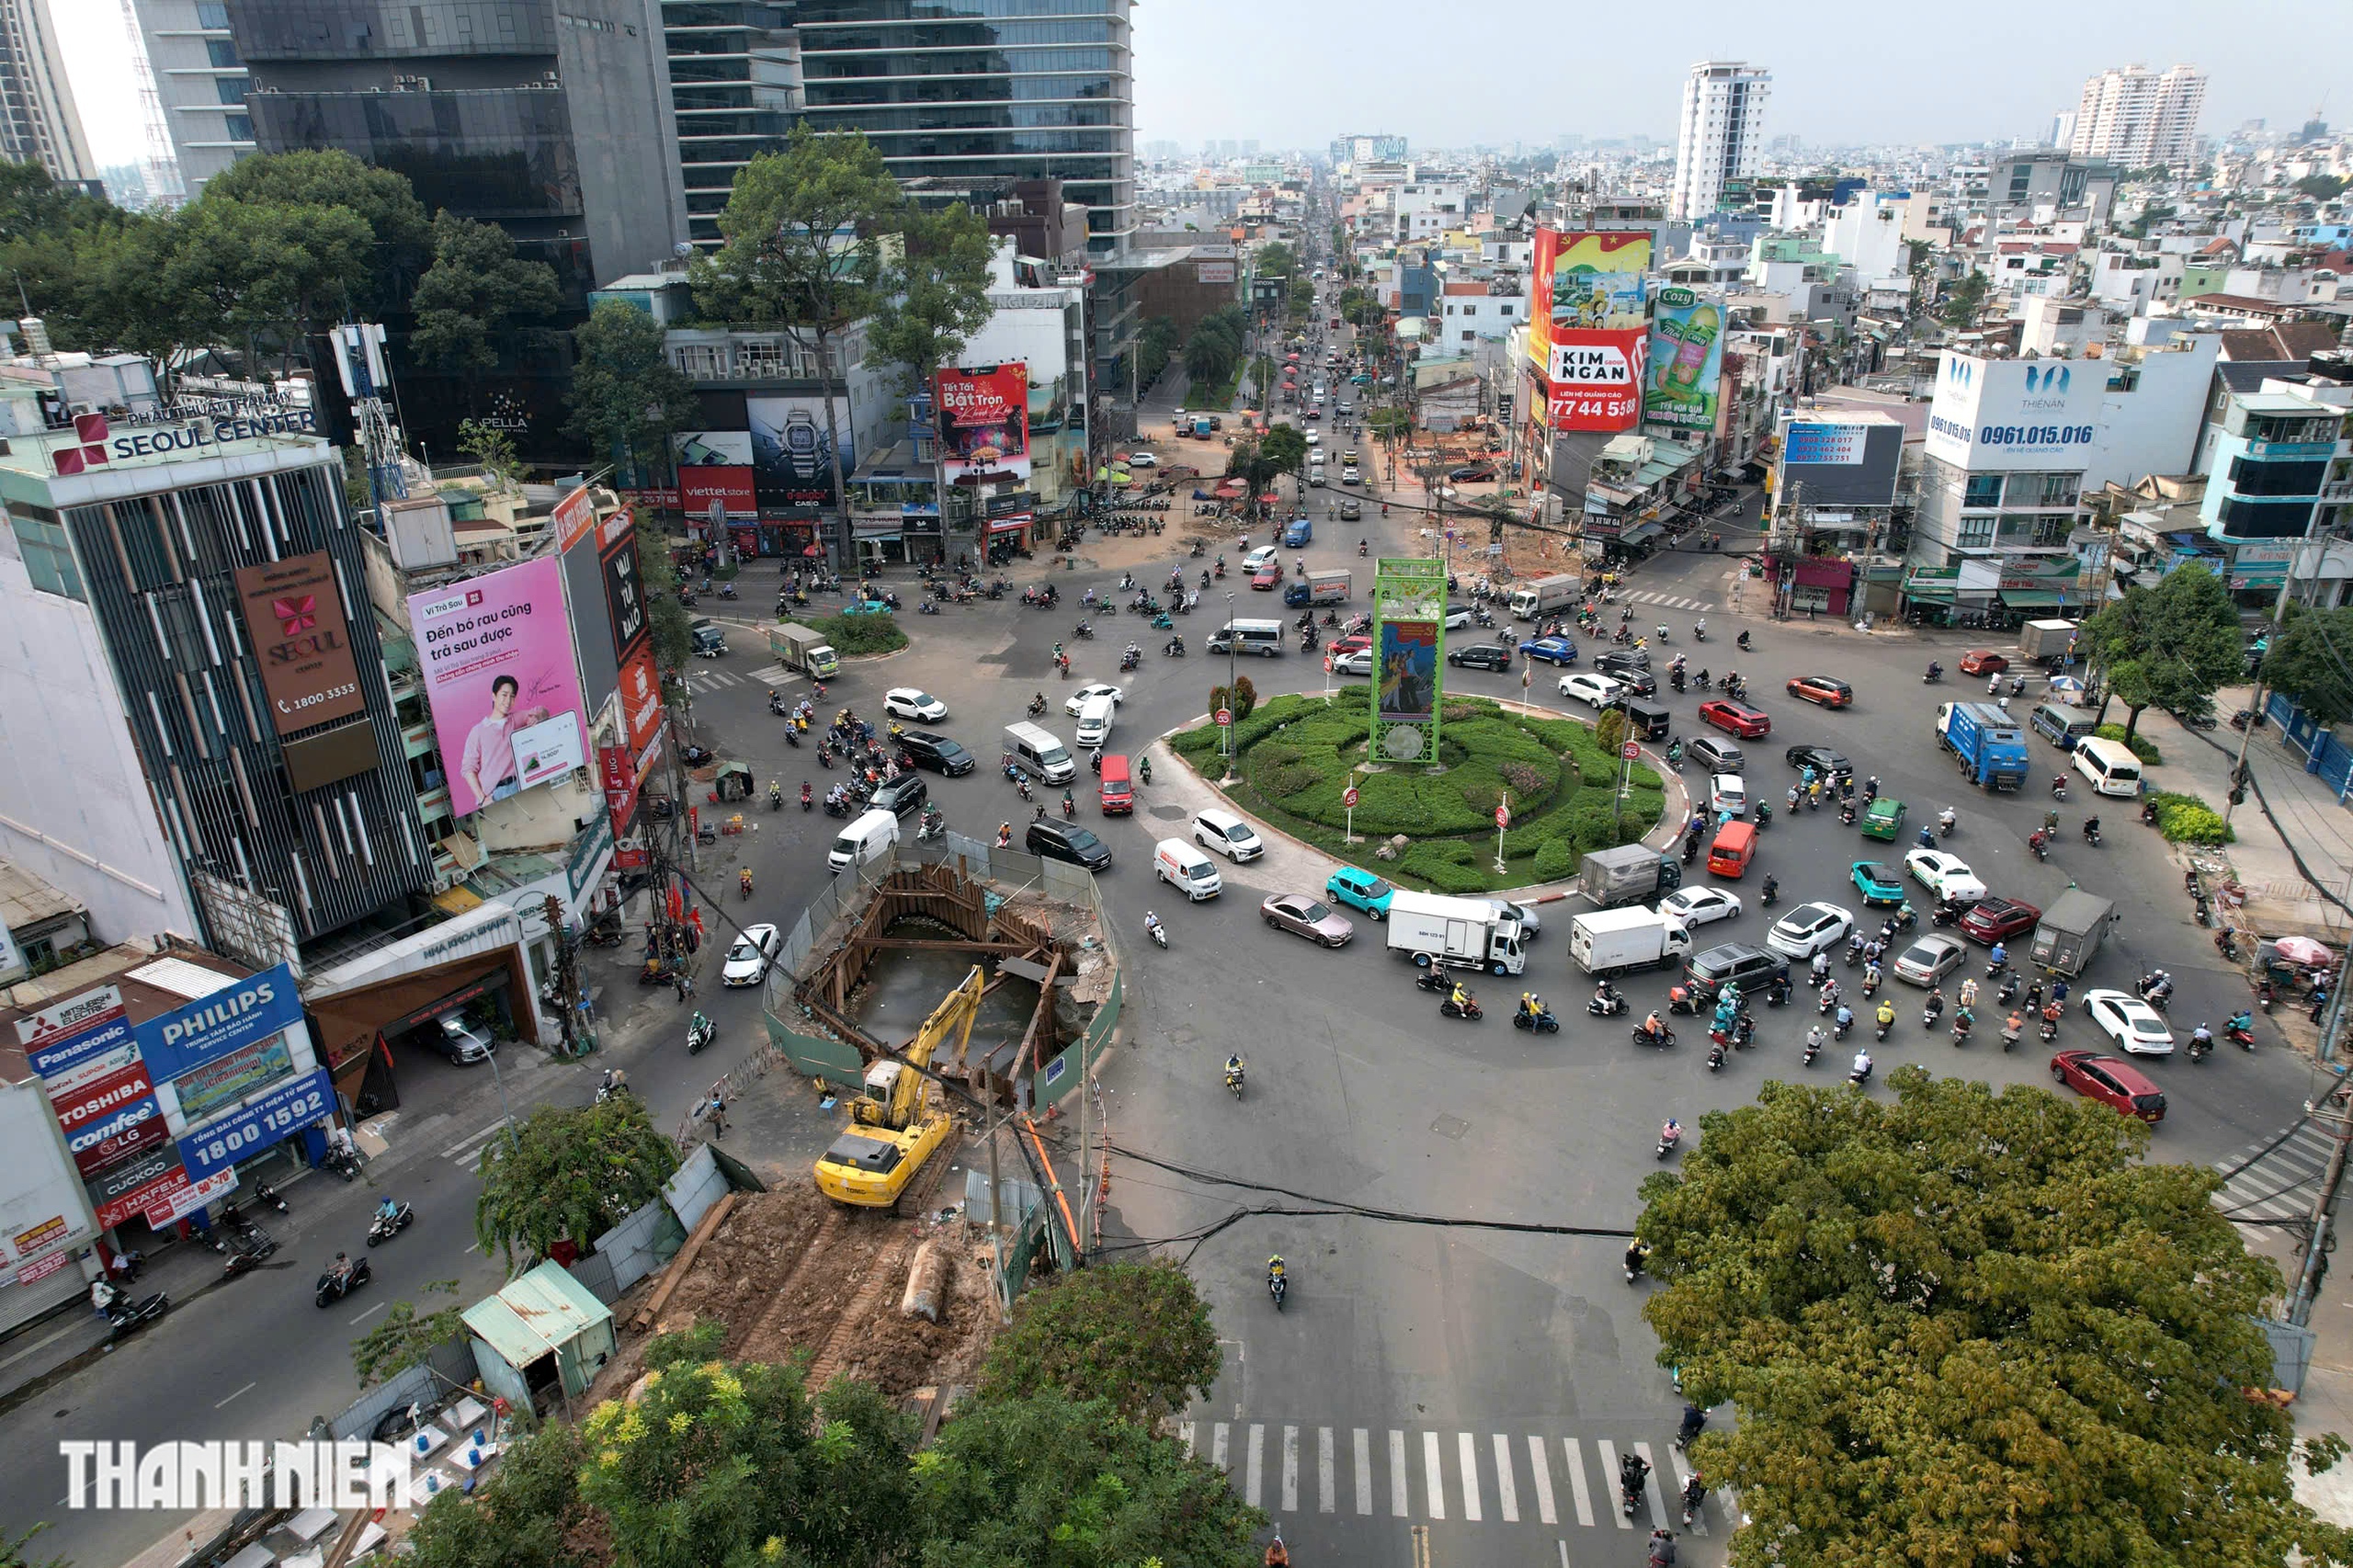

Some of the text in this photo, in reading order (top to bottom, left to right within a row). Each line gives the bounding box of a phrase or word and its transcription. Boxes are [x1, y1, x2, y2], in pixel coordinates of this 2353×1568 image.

[1663, 290, 1692, 304] Cozy
[1688, 332, 1706, 346] Cozy
[1563, 352, 1603, 365] KIM
[1563, 366, 1624, 380] NGAN
[943, 381, 958, 392] Tết
[127, 403, 172, 426] PHẪU
[172, 400, 223, 419] THUẬT
[943, 392, 1003, 411] Bật Trọn
[1578, 401, 1602, 415] 44
[114, 411, 317, 459] SEOUL CENTER
[462, 418, 528, 427] CPELLA
[1931, 415, 1972, 443] 0961.015.016
[1981, 426, 2093, 444] 0961.015.016
[686, 486, 726, 496] viettel
[1612, 518, 1620, 527] GA
[426, 602, 532, 643] Đến bó rau cũng
[269, 631, 343, 665] SEOUL
[430, 626, 513, 661] trả sau được
[294, 683, 356, 710] 1800 3333
[60, 993, 111, 1018] MITSUBISHI
[63, 1003, 108, 1025] ELECTRIC
[163, 983, 275, 1046] PHILIPS
[185, 1011, 263, 1049] TRUNG TÂM BẢO HÀNH
[199, 1022, 255, 1051] SERVICE CENTER
[38, 1026, 125, 1069] Panasonic
[77, 1063, 106, 1080] SUPOR
[59, 1080, 147, 1125] TOSHIBA
[192, 1129, 216, 1144] TỔNG
[232, 1111, 254, 1125] CÔNG
[265, 1096, 283, 1108] ĐIỆN
[297, 1078, 316, 1093] MINH
[118, 1130, 140, 1146] LG
[195, 1091, 323, 1165] 1800 1592
[108, 1162, 165, 1195] CUCKOO
[158, 1185, 185, 1200] CENTER
